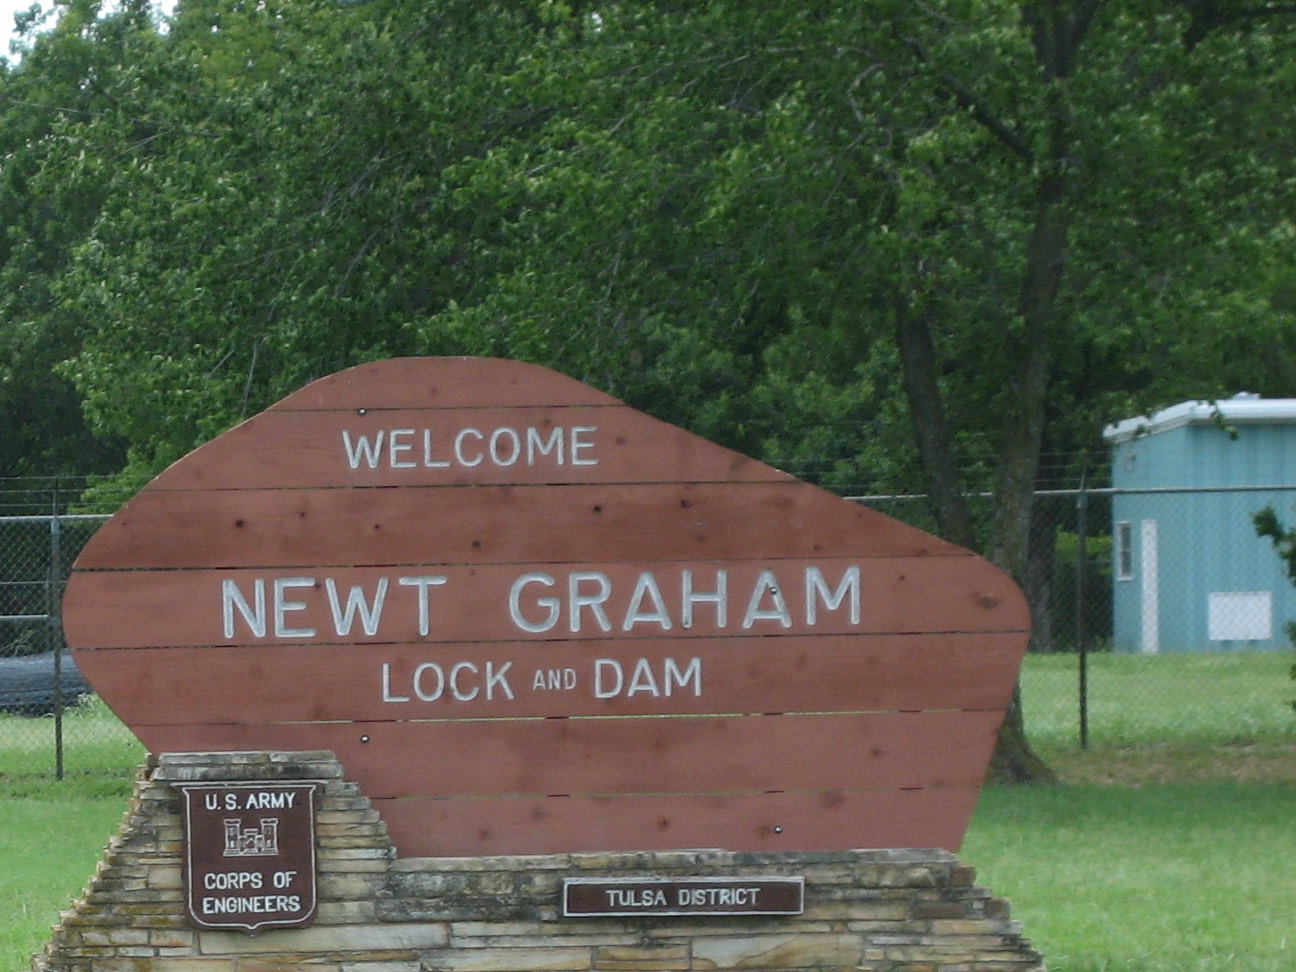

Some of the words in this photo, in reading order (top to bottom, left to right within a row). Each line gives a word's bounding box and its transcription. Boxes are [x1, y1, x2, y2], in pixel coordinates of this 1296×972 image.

[341, 425, 600, 470] WELCOME
[221, 575, 448, 639] NEWT
[508, 565, 861, 633] GRAHAM
[382, 660, 516, 703] LOCK
[532, 668, 577, 691] AND
[594, 656, 703, 700] DAM
[245, 792, 296, 810] ARMY
[204, 872, 263, 890] CORPS
[273, 871, 297, 889] OF
[203, 895, 301, 914] ENGINEERS
[606, 889, 667, 907] TULSA
[678, 888, 761, 906] DISTRICT
